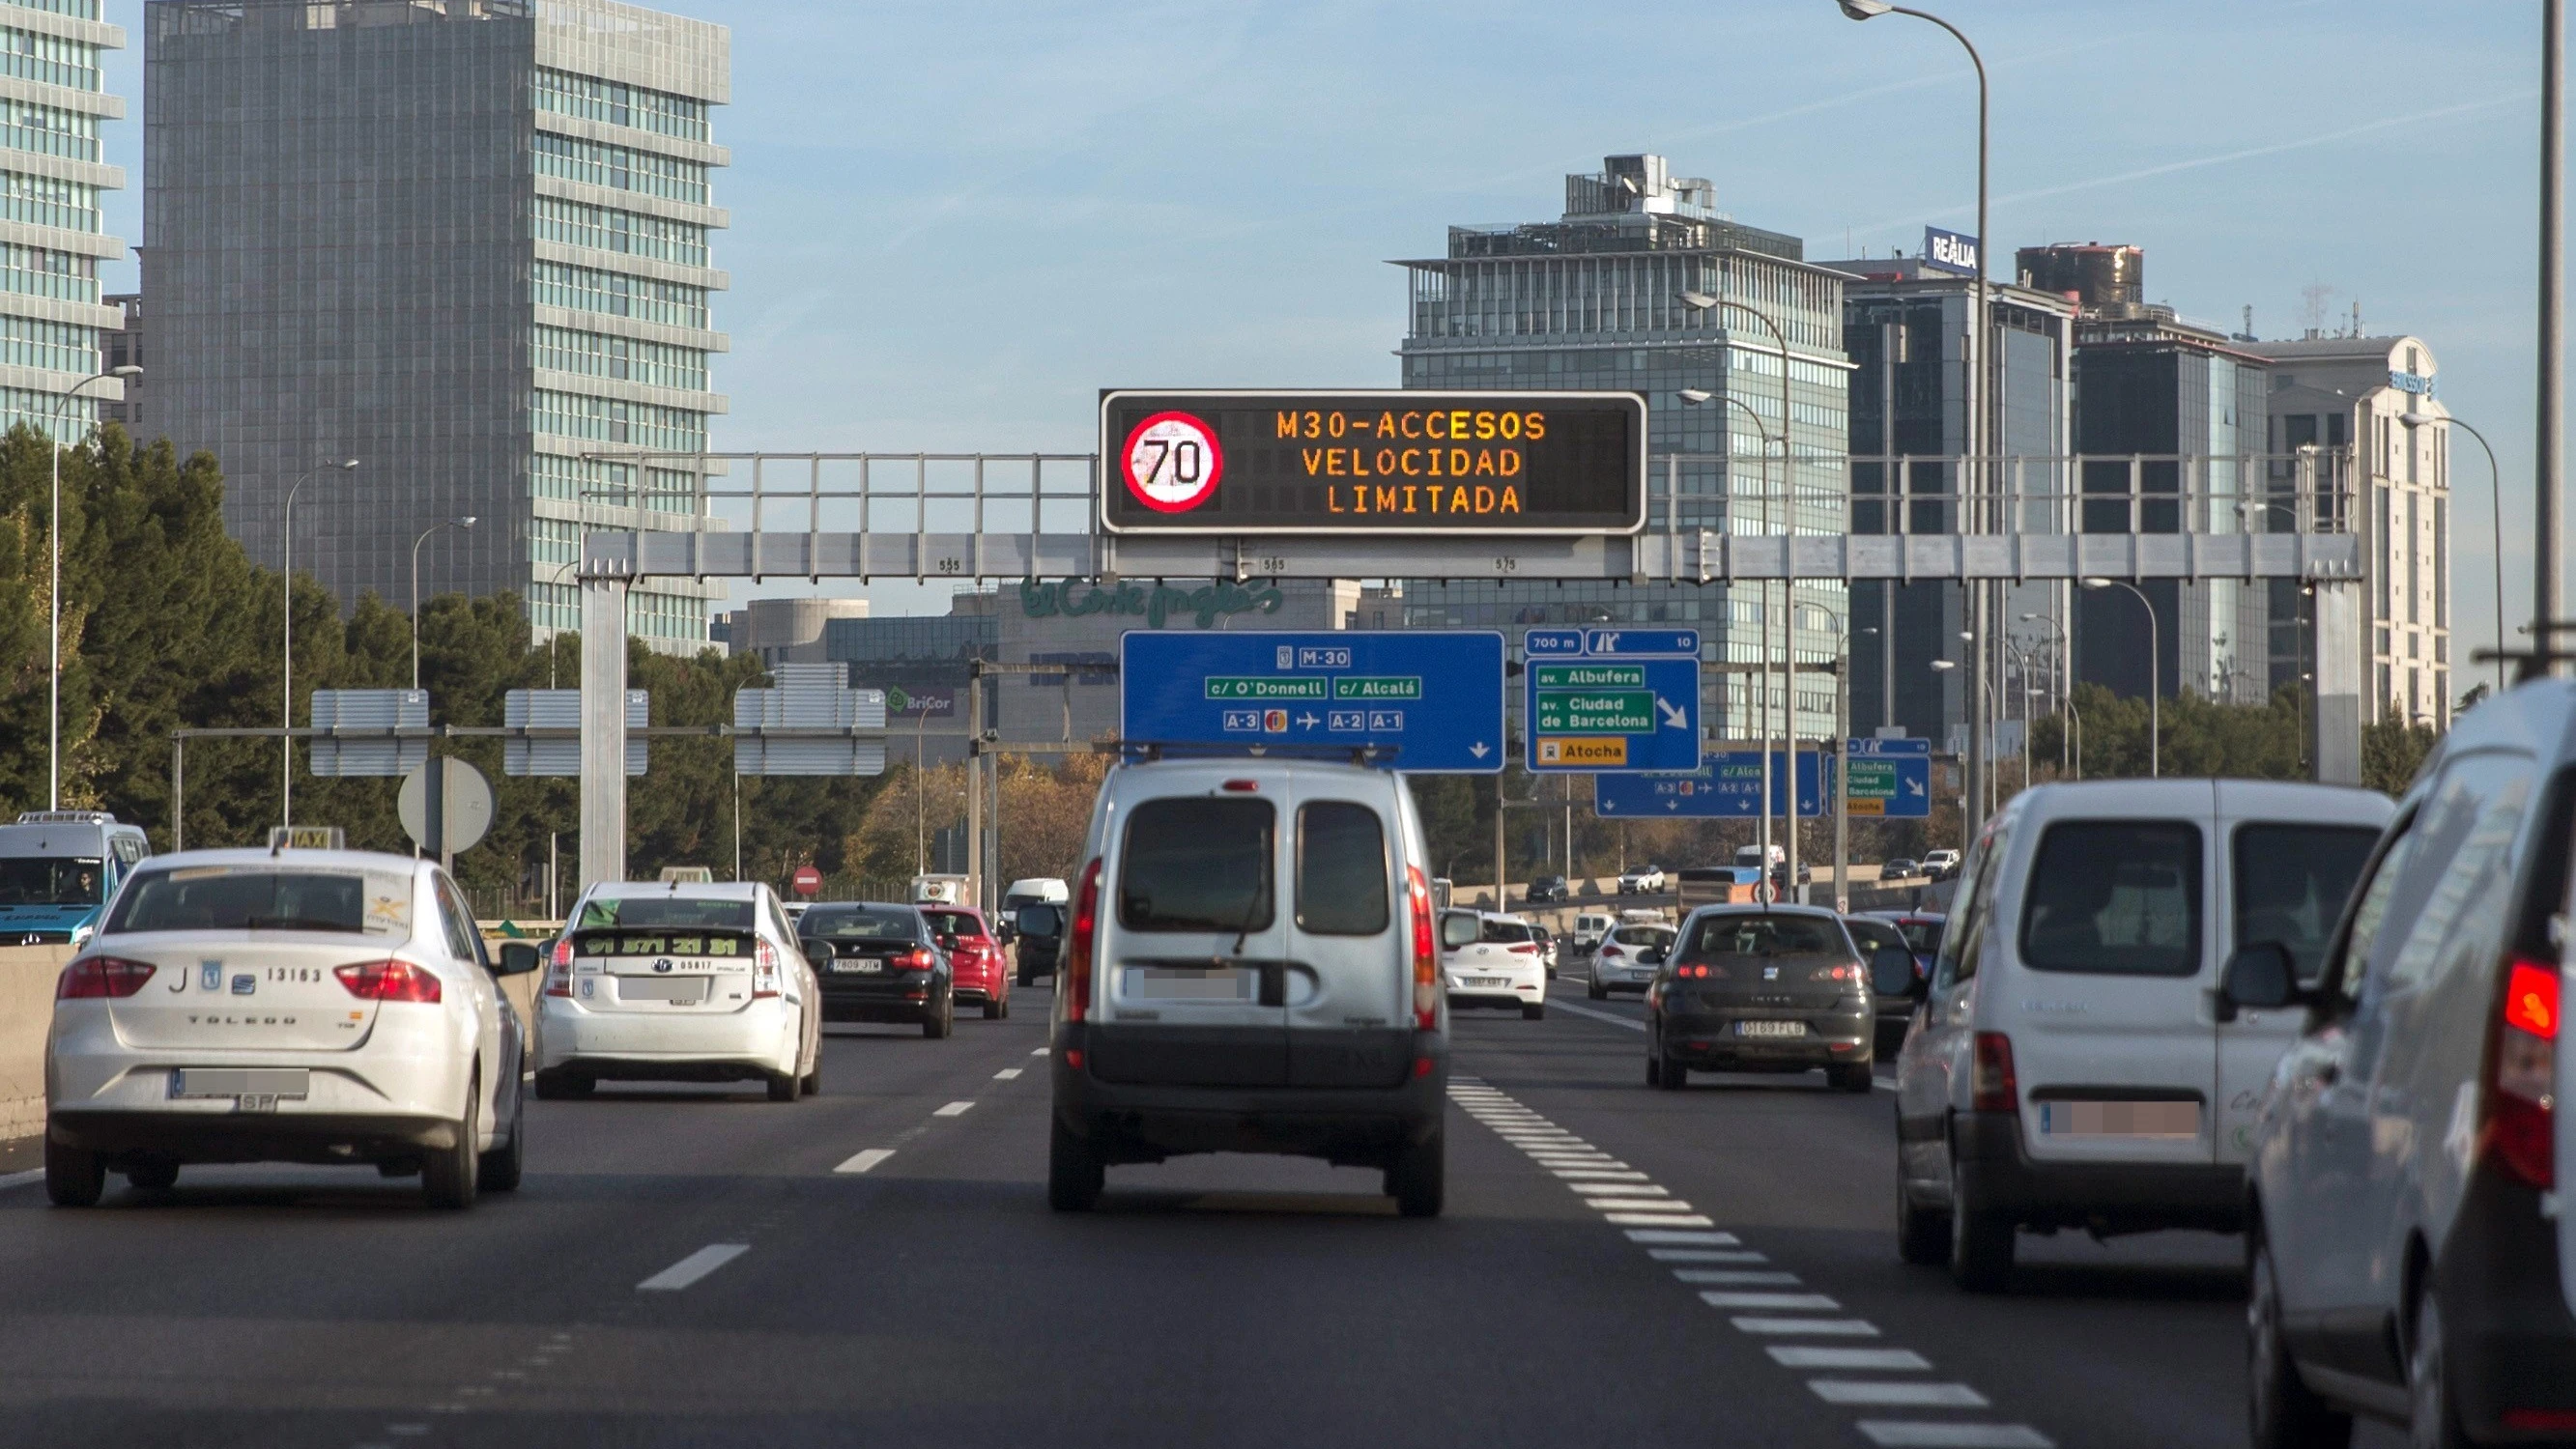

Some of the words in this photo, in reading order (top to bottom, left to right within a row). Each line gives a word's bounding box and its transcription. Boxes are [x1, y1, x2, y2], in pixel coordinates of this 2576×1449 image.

[1277, 411, 1546, 440] M30-ACCESOS
[1143, 440, 1201, 485] 70
[1302, 447, 1521, 476] VELOCIDAD
[1328, 486, 1520, 513] LIMITADA
[1533, 638, 1558, 647] 700
[1563, 639, 1575, 648] m
[1677, 638, 1691, 647] 10
[1302, 651, 1348, 665] M-30
[1540, 674, 1558, 683] av.
[1568, 670, 1640, 683] Albufera
[1211, 682, 1228, 696] c/
[1236, 681, 1322, 696] O'Donnell
[1339, 682, 1356, 696] c/
[1362, 680, 1415, 696] Alcalá
[906, 696, 951, 710] BriCor
[1541, 701, 1560, 711] av.
[1569, 697, 1624, 711] Ciudad
[1226, 714, 1257, 728] A-3
[1331, 715, 1361, 727] A-2
[1372, 715, 1400, 727] A-1
[1541, 715, 1560, 727] de
[1569, 715, 1648, 727] Barcelona
[1565, 745, 1622, 758] Atocha
[1851, 762, 1893, 771] Albufera
[1656, 782, 1674, 792] A-3
[1848, 786, 1895, 796] Barcelona
[294, 831, 329, 848] TAXI
[243, 1094, 275, 1110] SP
